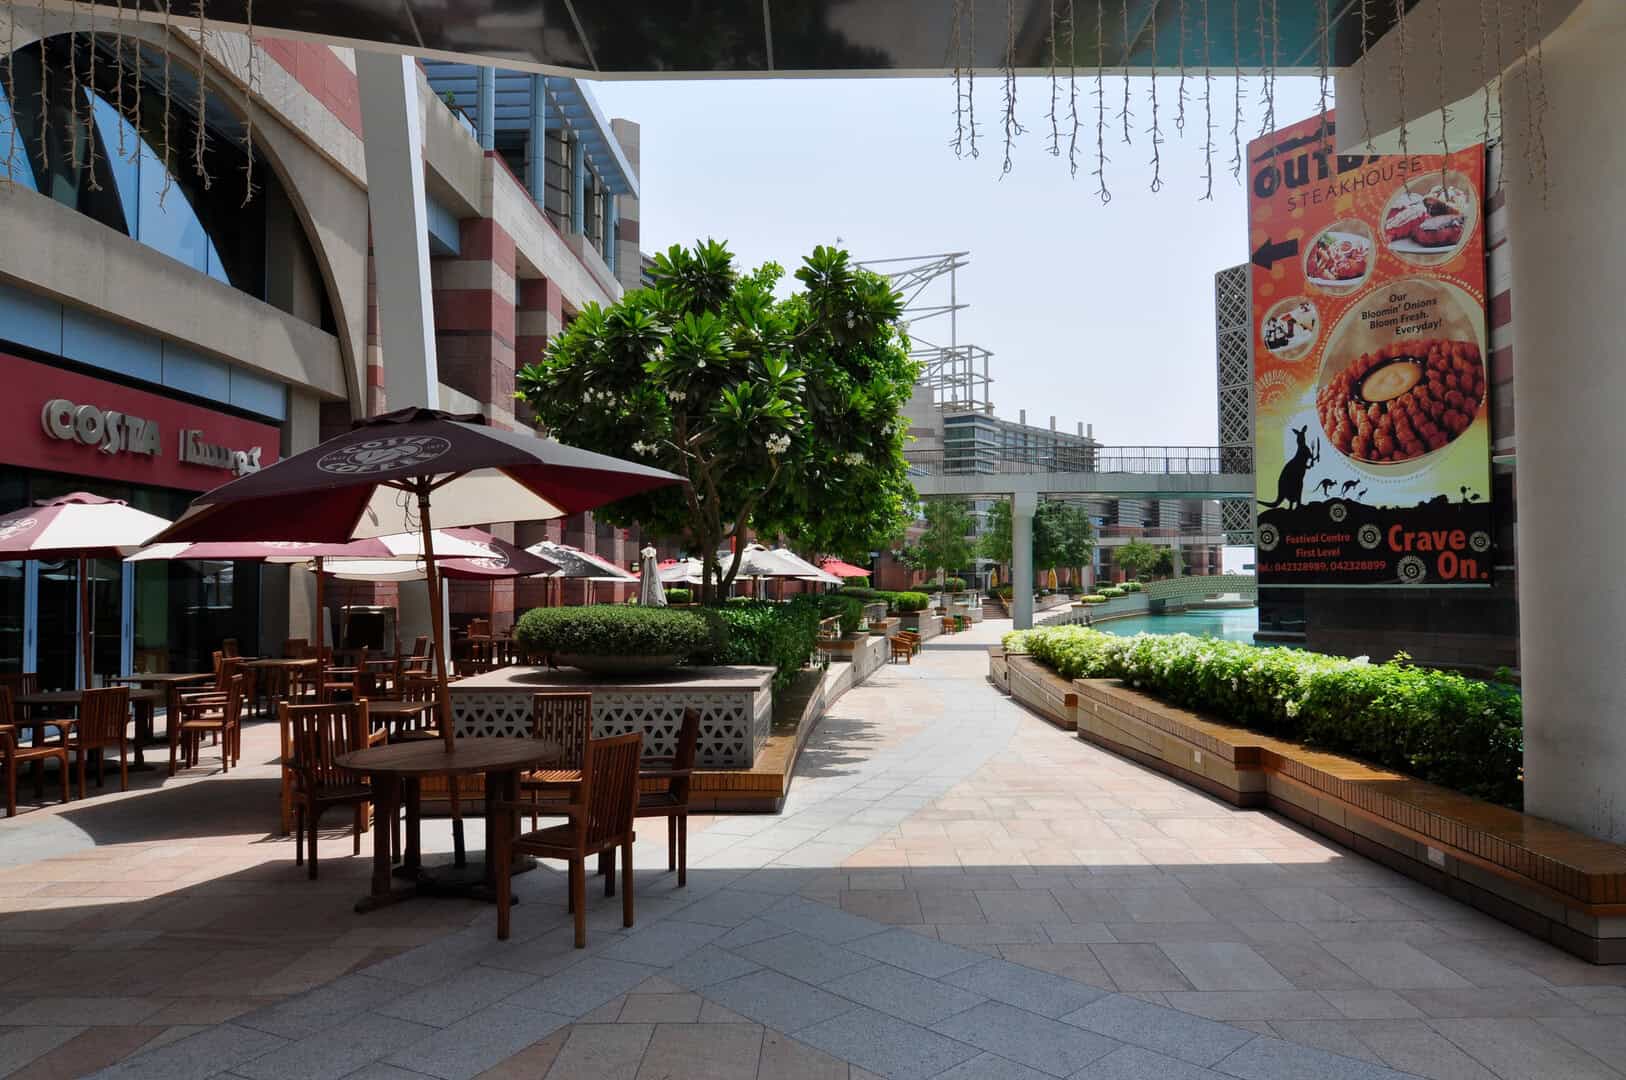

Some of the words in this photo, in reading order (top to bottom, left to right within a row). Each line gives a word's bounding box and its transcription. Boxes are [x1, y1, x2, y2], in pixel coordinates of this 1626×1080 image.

[1287, 156, 1423, 212] STEAKHOUSE
[1389, 293, 1407, 303] Our
[1361, 304, 1401, 320] Bloomin'
[1403, 298, 1437, 311] Onions
[1369, 317, 1399, 329] Bloom
[1395, 317, 1442, 335] Everyday!
[41, 398, 162, 456] COSTA
[1285, 533, 1319, 545] Festival
[1388, 523, 1466, 552] Crave
[1295, 547, 1316, 558] First
[1316, 547, 1341, 557] Level
[1437, 550, 1488, 580] On.
